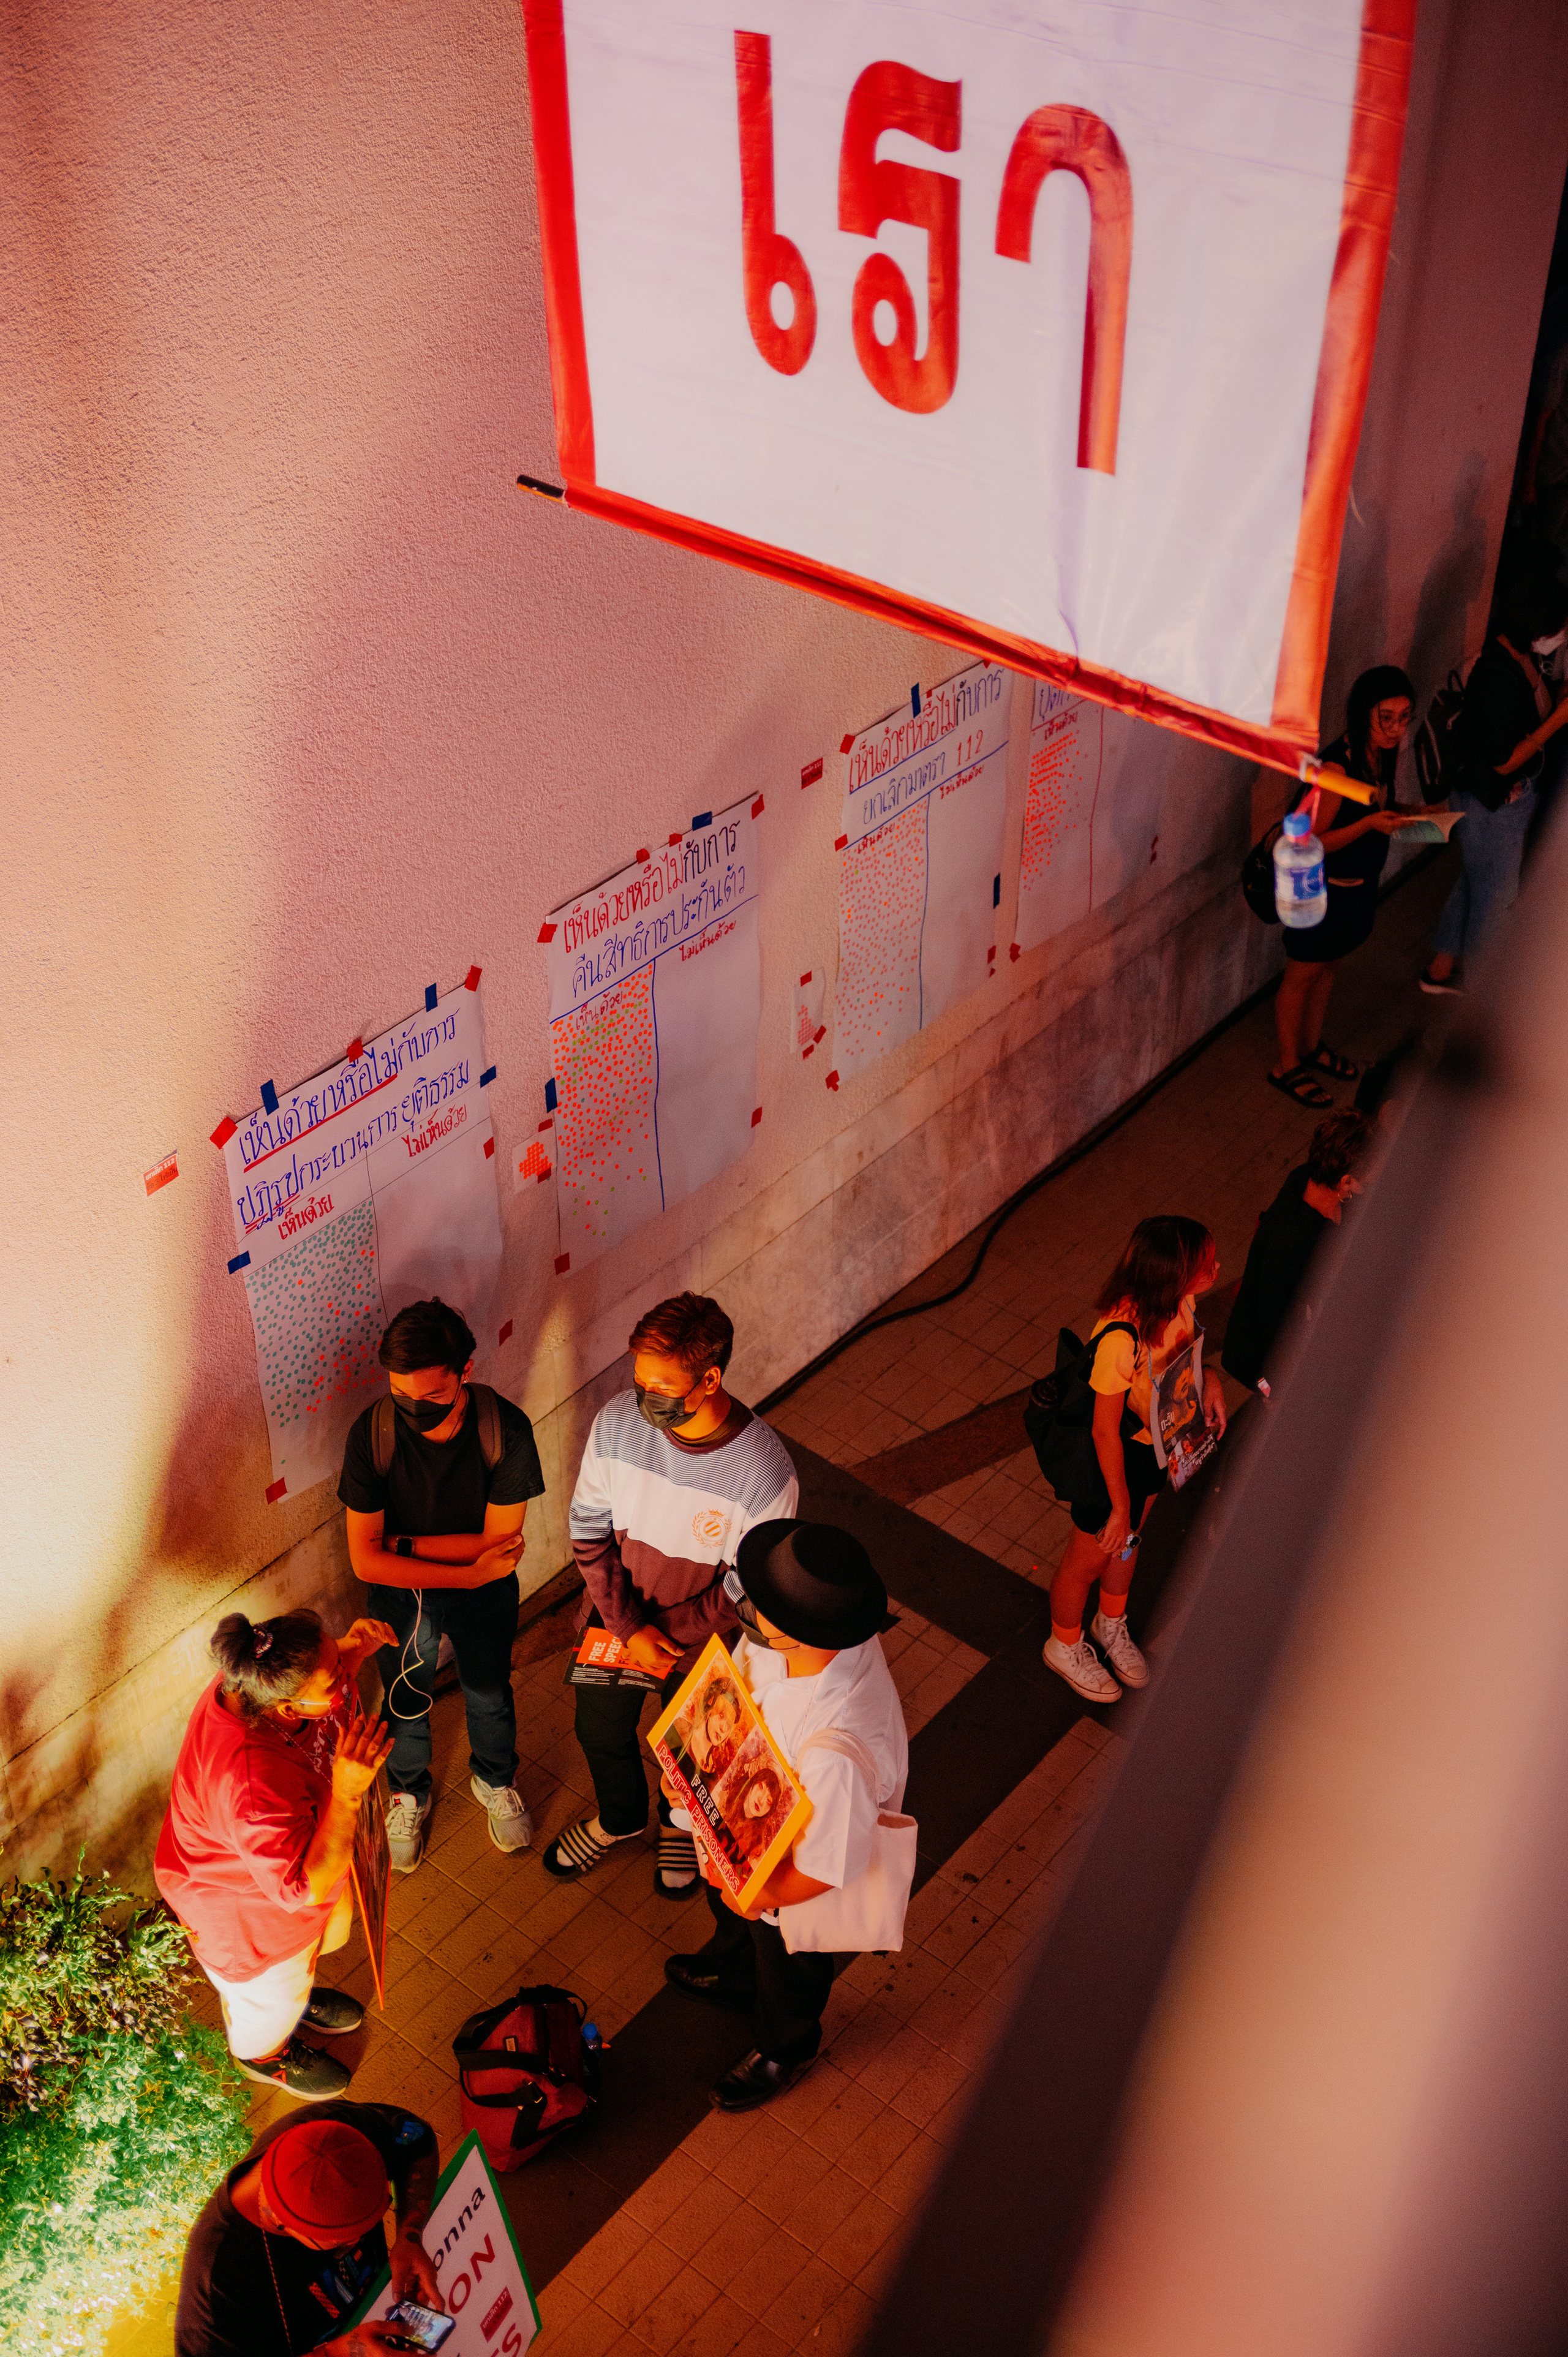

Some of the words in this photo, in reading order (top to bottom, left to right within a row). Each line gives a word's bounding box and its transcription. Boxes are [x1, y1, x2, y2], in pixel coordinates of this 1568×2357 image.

[957, 730, 984, 766] 112
[401, 1104, 467, 1158] ไม่เห็นด้วย
[164, 1158, 175, 1169] 112
[278, 1194, 334, 1240] เห็นด้วย
[588, 1641, 606, 1662] FREE
[603, 1636, 622, 1664] SPEEC
[658, 1744, 692, 1805] POLITIC
[690, 1804, 740, 1891] PRISONERS
[690, 1774, 719, 1827] FREE
